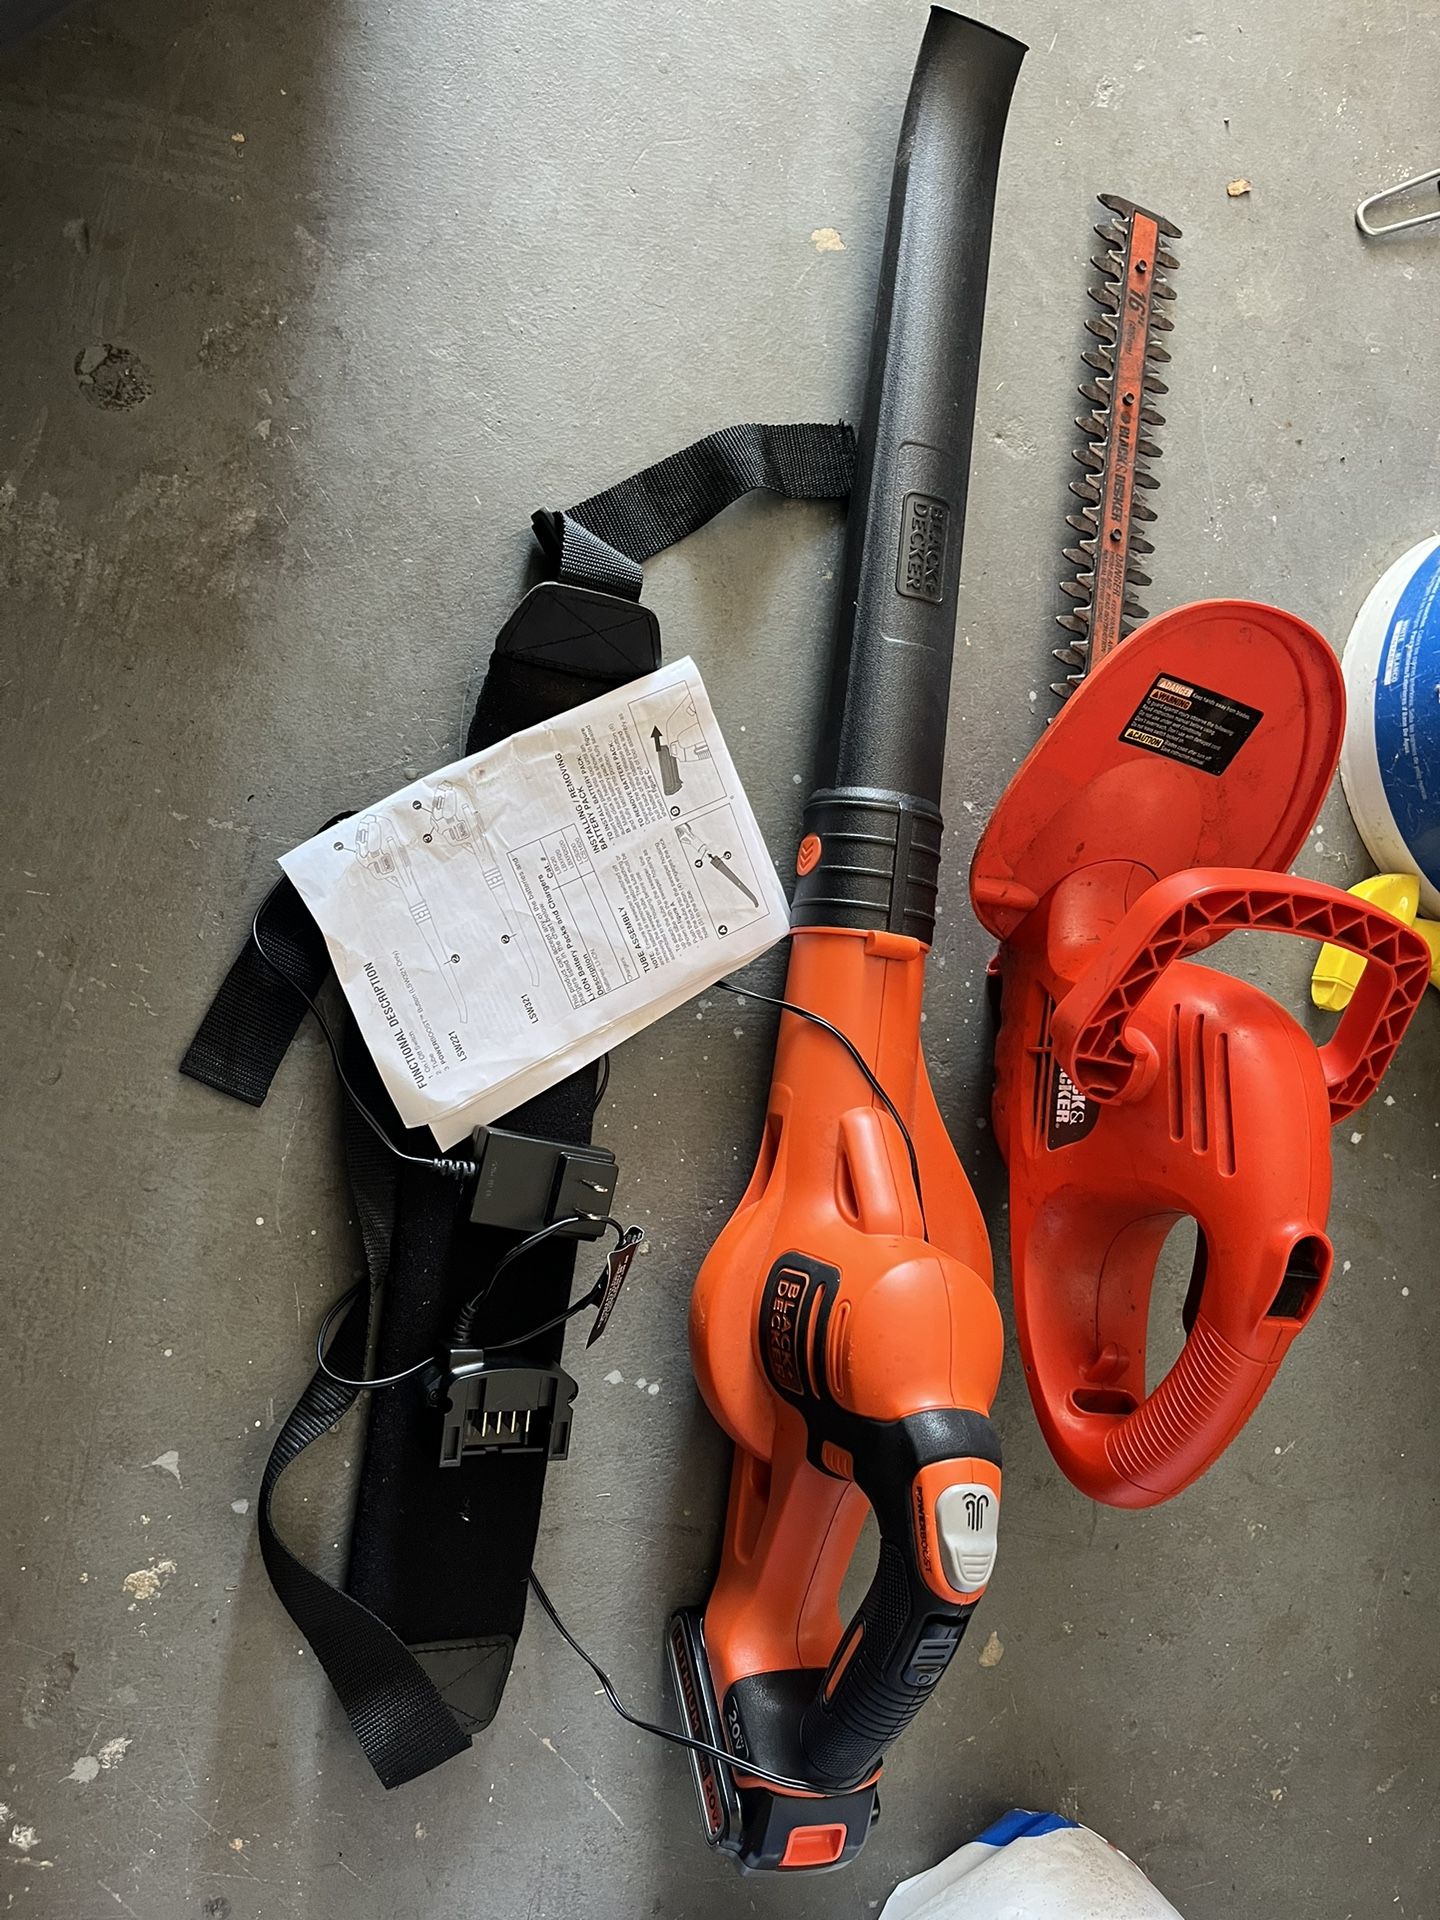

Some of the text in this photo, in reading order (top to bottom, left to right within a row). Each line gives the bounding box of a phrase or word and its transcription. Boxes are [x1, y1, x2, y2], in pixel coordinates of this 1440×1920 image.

[906, 501, 928, 590] DECKER
[1390, 652, 1402, 683] BLANCO
[1156, 691, 1190, 709] WARNING
[1132, 731, 1162, 747] CAUTION
[554, 753, 576, 798] REMOVING
[615, 761, 629, 789] BATTERY
[647, 775, 656, 792] figure
[583, 775, 598, 804] BATTERY
[576, 786, 607, 849] BATTERY PACK
[626, 791, 640, 817] REMOVE
[575, 804, 599, 853] INSTALLING
[596, 805, 609, 831] INSTALL
[512, 857, 521, 870] and
[544, 863, 553, 878] Cat.
[519, 871, 534, 900] batteries
[538, 874, 555, 908] Chargers
[531, 900, 539, 911] the
[552, 909, 562, 924] and
[672, 907, 681, 924] figure
[545, 933, 558, 955] accept
[555, 940, 563, 951] the
[560, 925, 572, 948] Packs
[618, 907, 649, 972] TUBE ASSEMBLY
[555, 955, 563, 968] can
[570, 950, 585, 976] Battery
[583, 953, 604, 995] Description
[560, 969, 575, 993] product
[521, 994, 538, 1023] LSW321
[571, 993, 580, 1007] This
[364, 962, 426, 1088] FUNCTIONAL DESCRIPTION
[448, 1031, 466, 1061] LSW221
[771, 1280, 787, 1377] DECKER
[916, 1486, 932, 1573] POWERBOOST
[675, 1635, 700, 1732] LITHIUM
